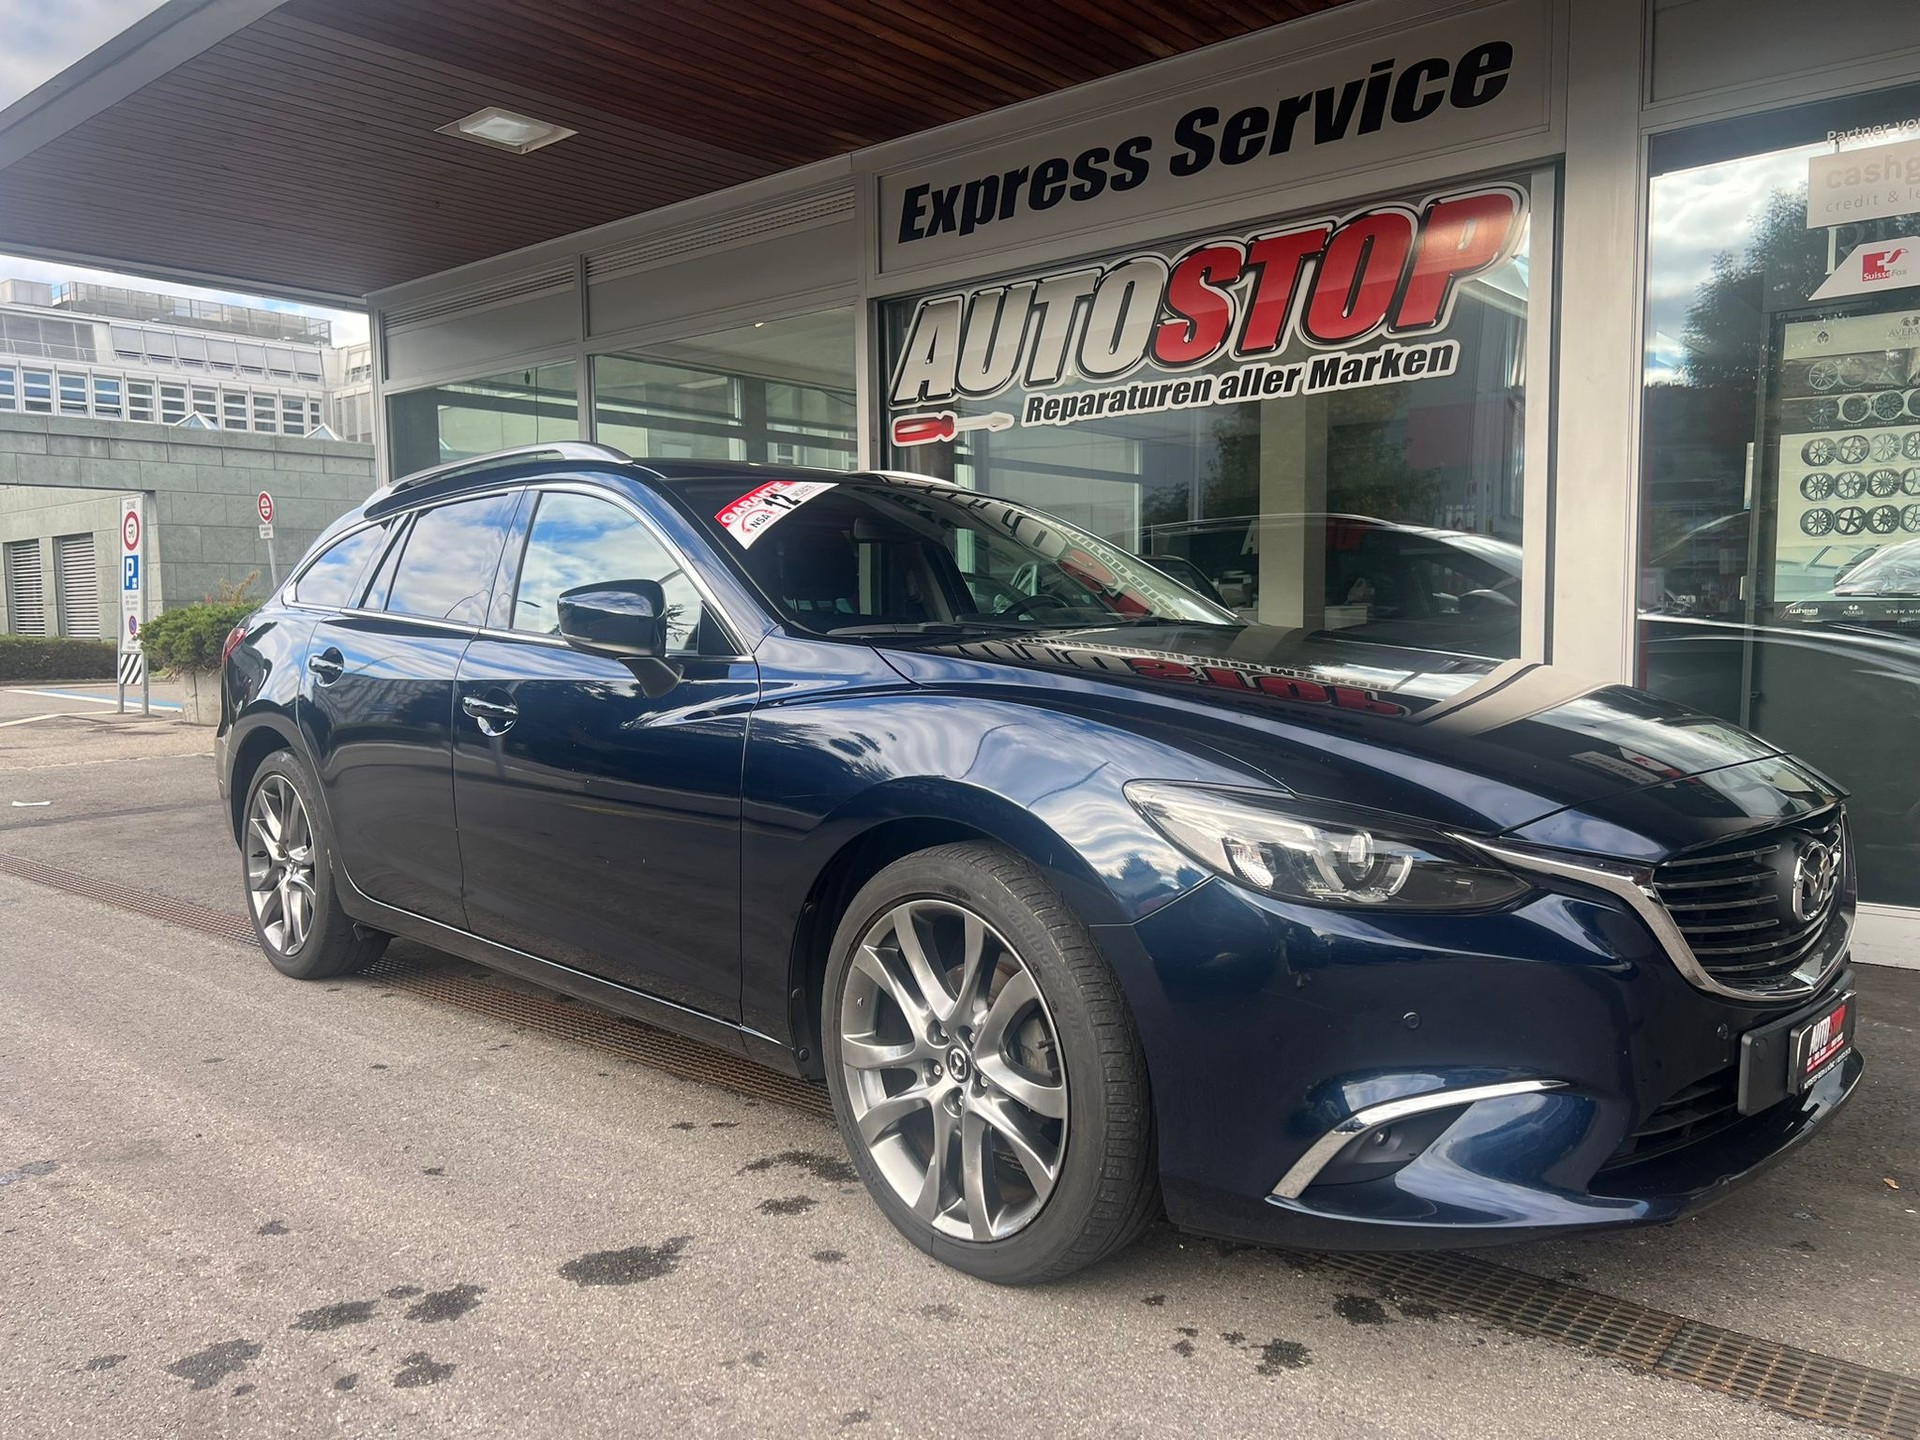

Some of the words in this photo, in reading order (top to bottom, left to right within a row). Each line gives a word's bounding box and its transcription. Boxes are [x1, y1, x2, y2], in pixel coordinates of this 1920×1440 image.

[898, 136, 1152, 245] Express
[1169, 40, 1514, 178] Service
[1826, 122, 1890, 144] Partner
[1826, 195, 1879, 213] credit
[1887, 190, 1899, 203] &
[890, 187, 1525, 407] AUTOSTOP
[1025, 377, 1212, 425] Reparaturen
[1218, 363, 1303, 401] aller
[1309, 340, 1454, 387] Marken
[720, 482, 788, 524] GARANTIE
[763, 493, 802, 510] 12
[750, 514, 771, 529] NSA
